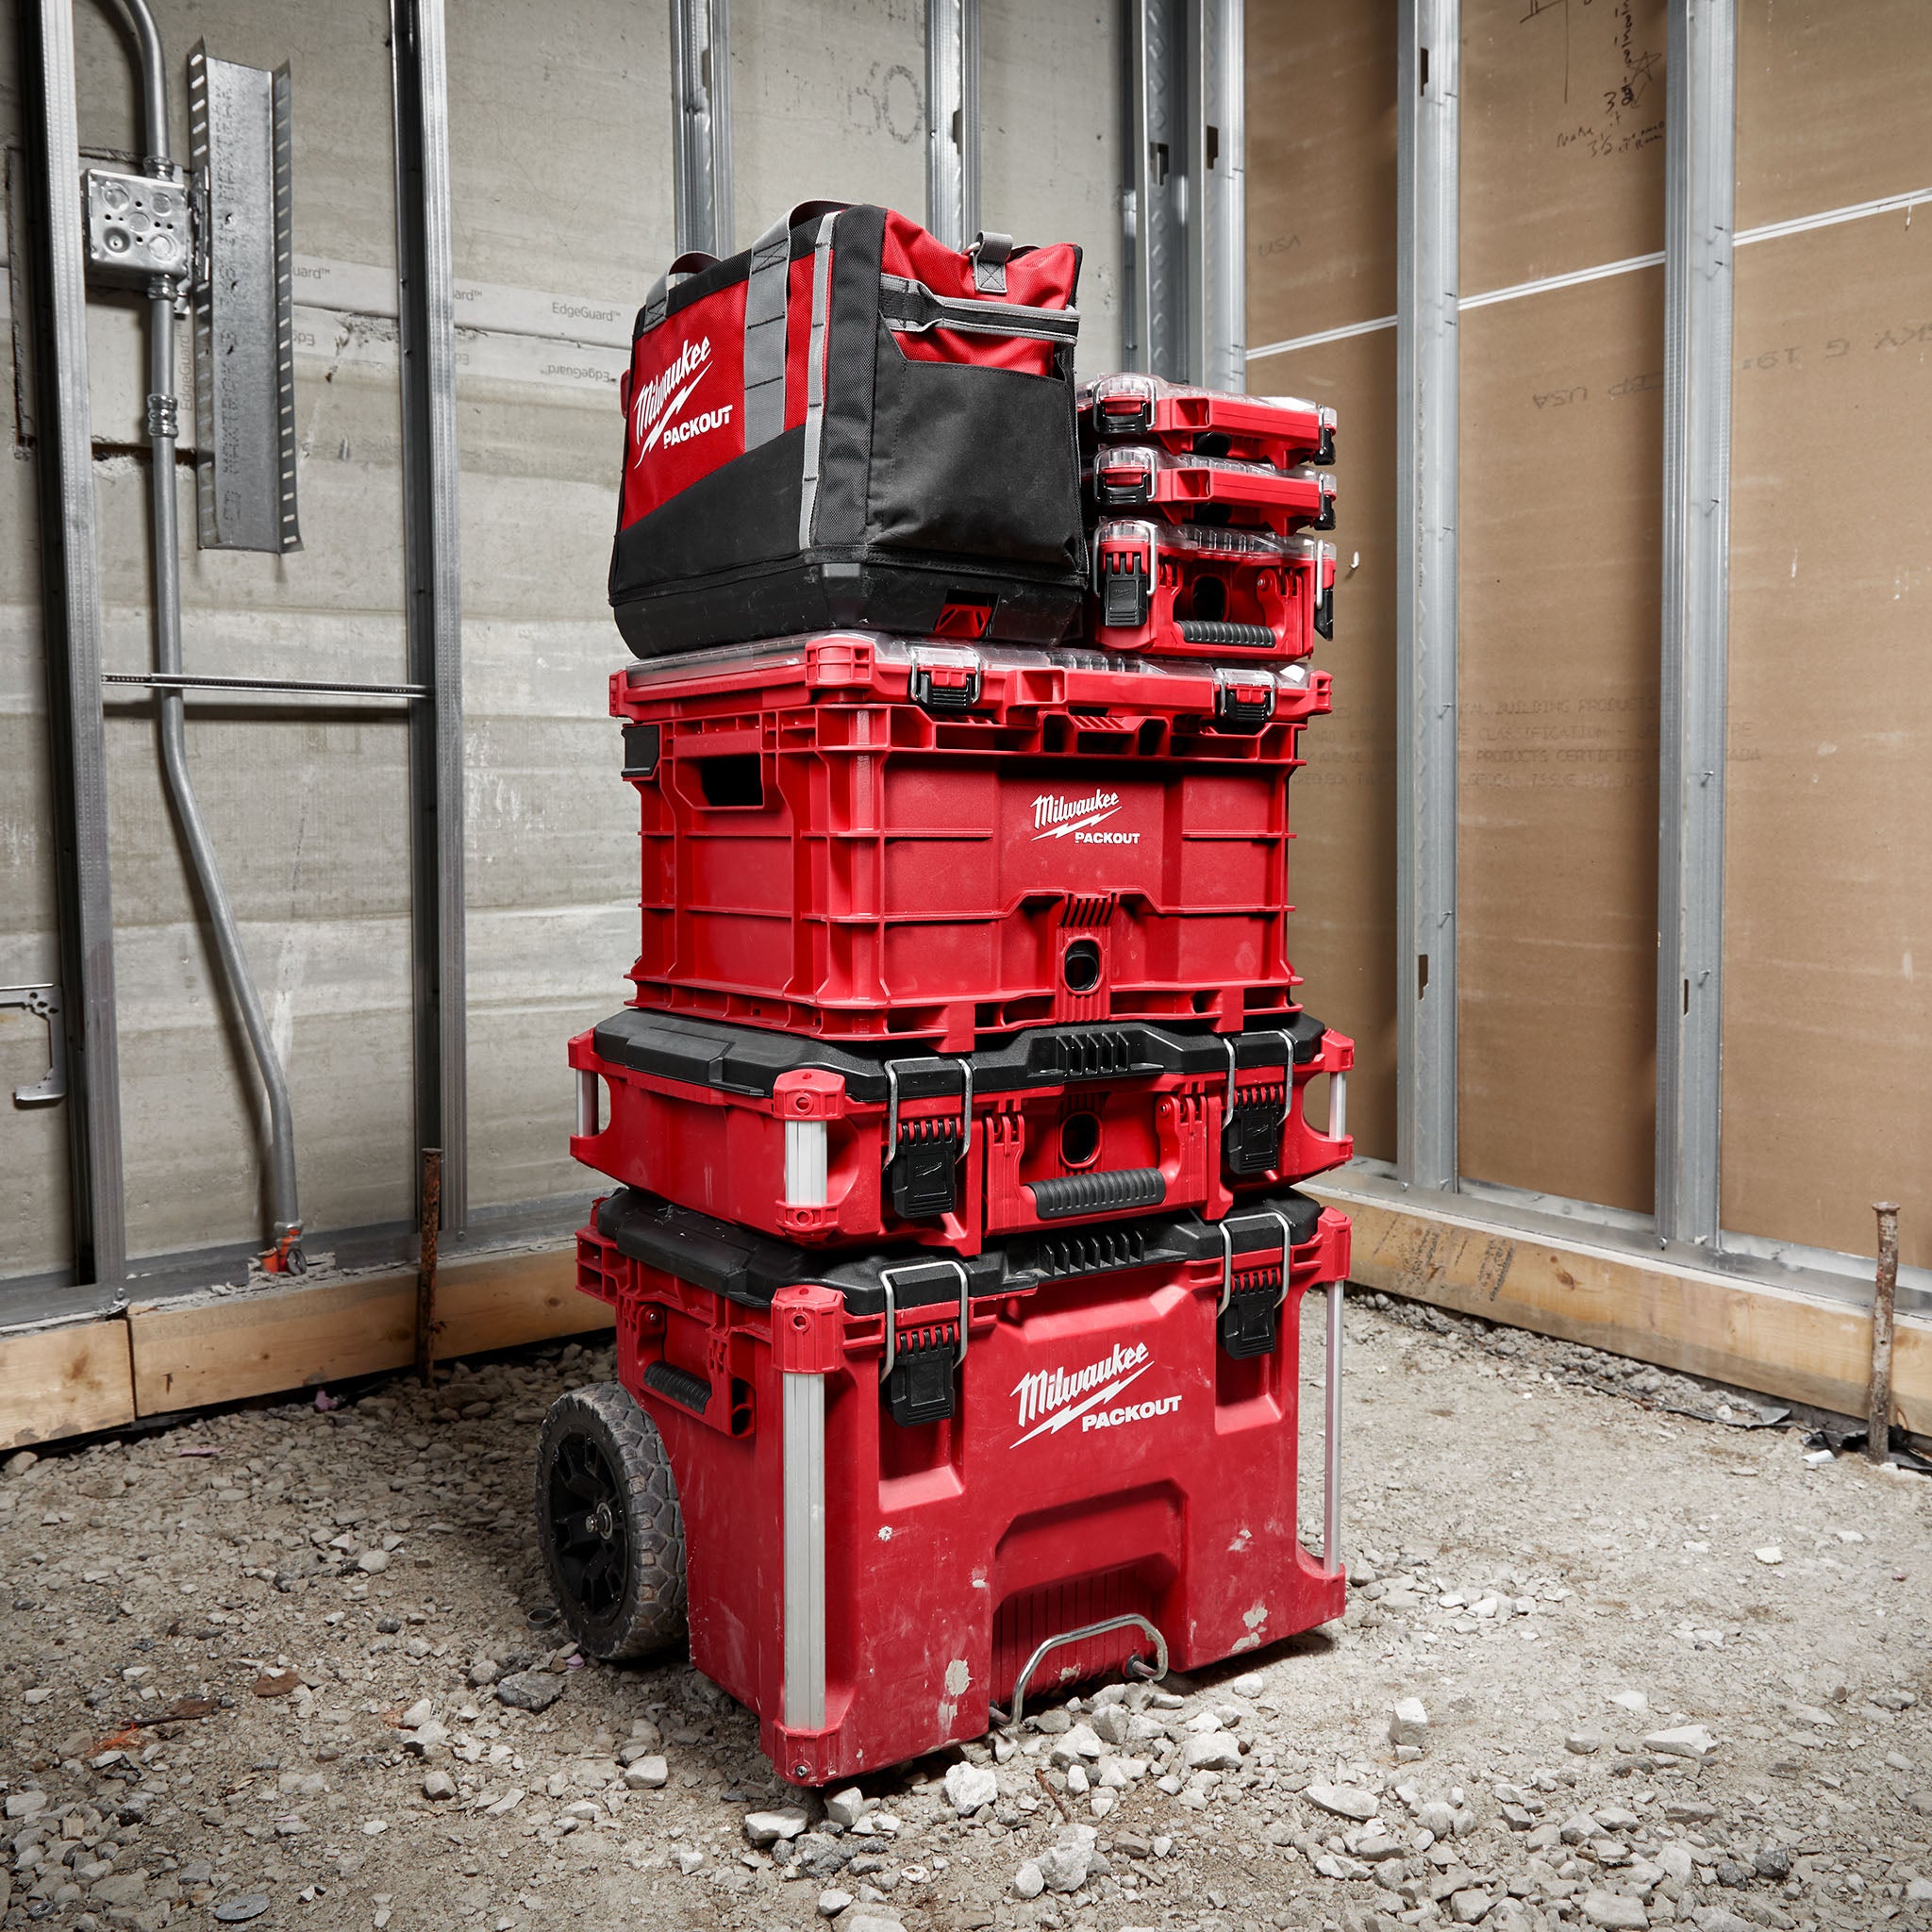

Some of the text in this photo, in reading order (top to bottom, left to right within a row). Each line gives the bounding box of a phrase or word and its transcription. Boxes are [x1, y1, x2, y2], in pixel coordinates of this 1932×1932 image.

[1258, 234, 1301, 258] USA
[633, 336, 712, 447] Milwaukee
[1532, 387, 1588, 409] USA
[663, 404, 734, 451] PACKOUT
[1029, 789, 1120, 829] Milwaukee
[1074, 832, 1141, 844] PACKOUT
[1009, 1341, 1150, 1428] Milwaukee
[1081, 1394, 1183, 1433] PACKOUT
